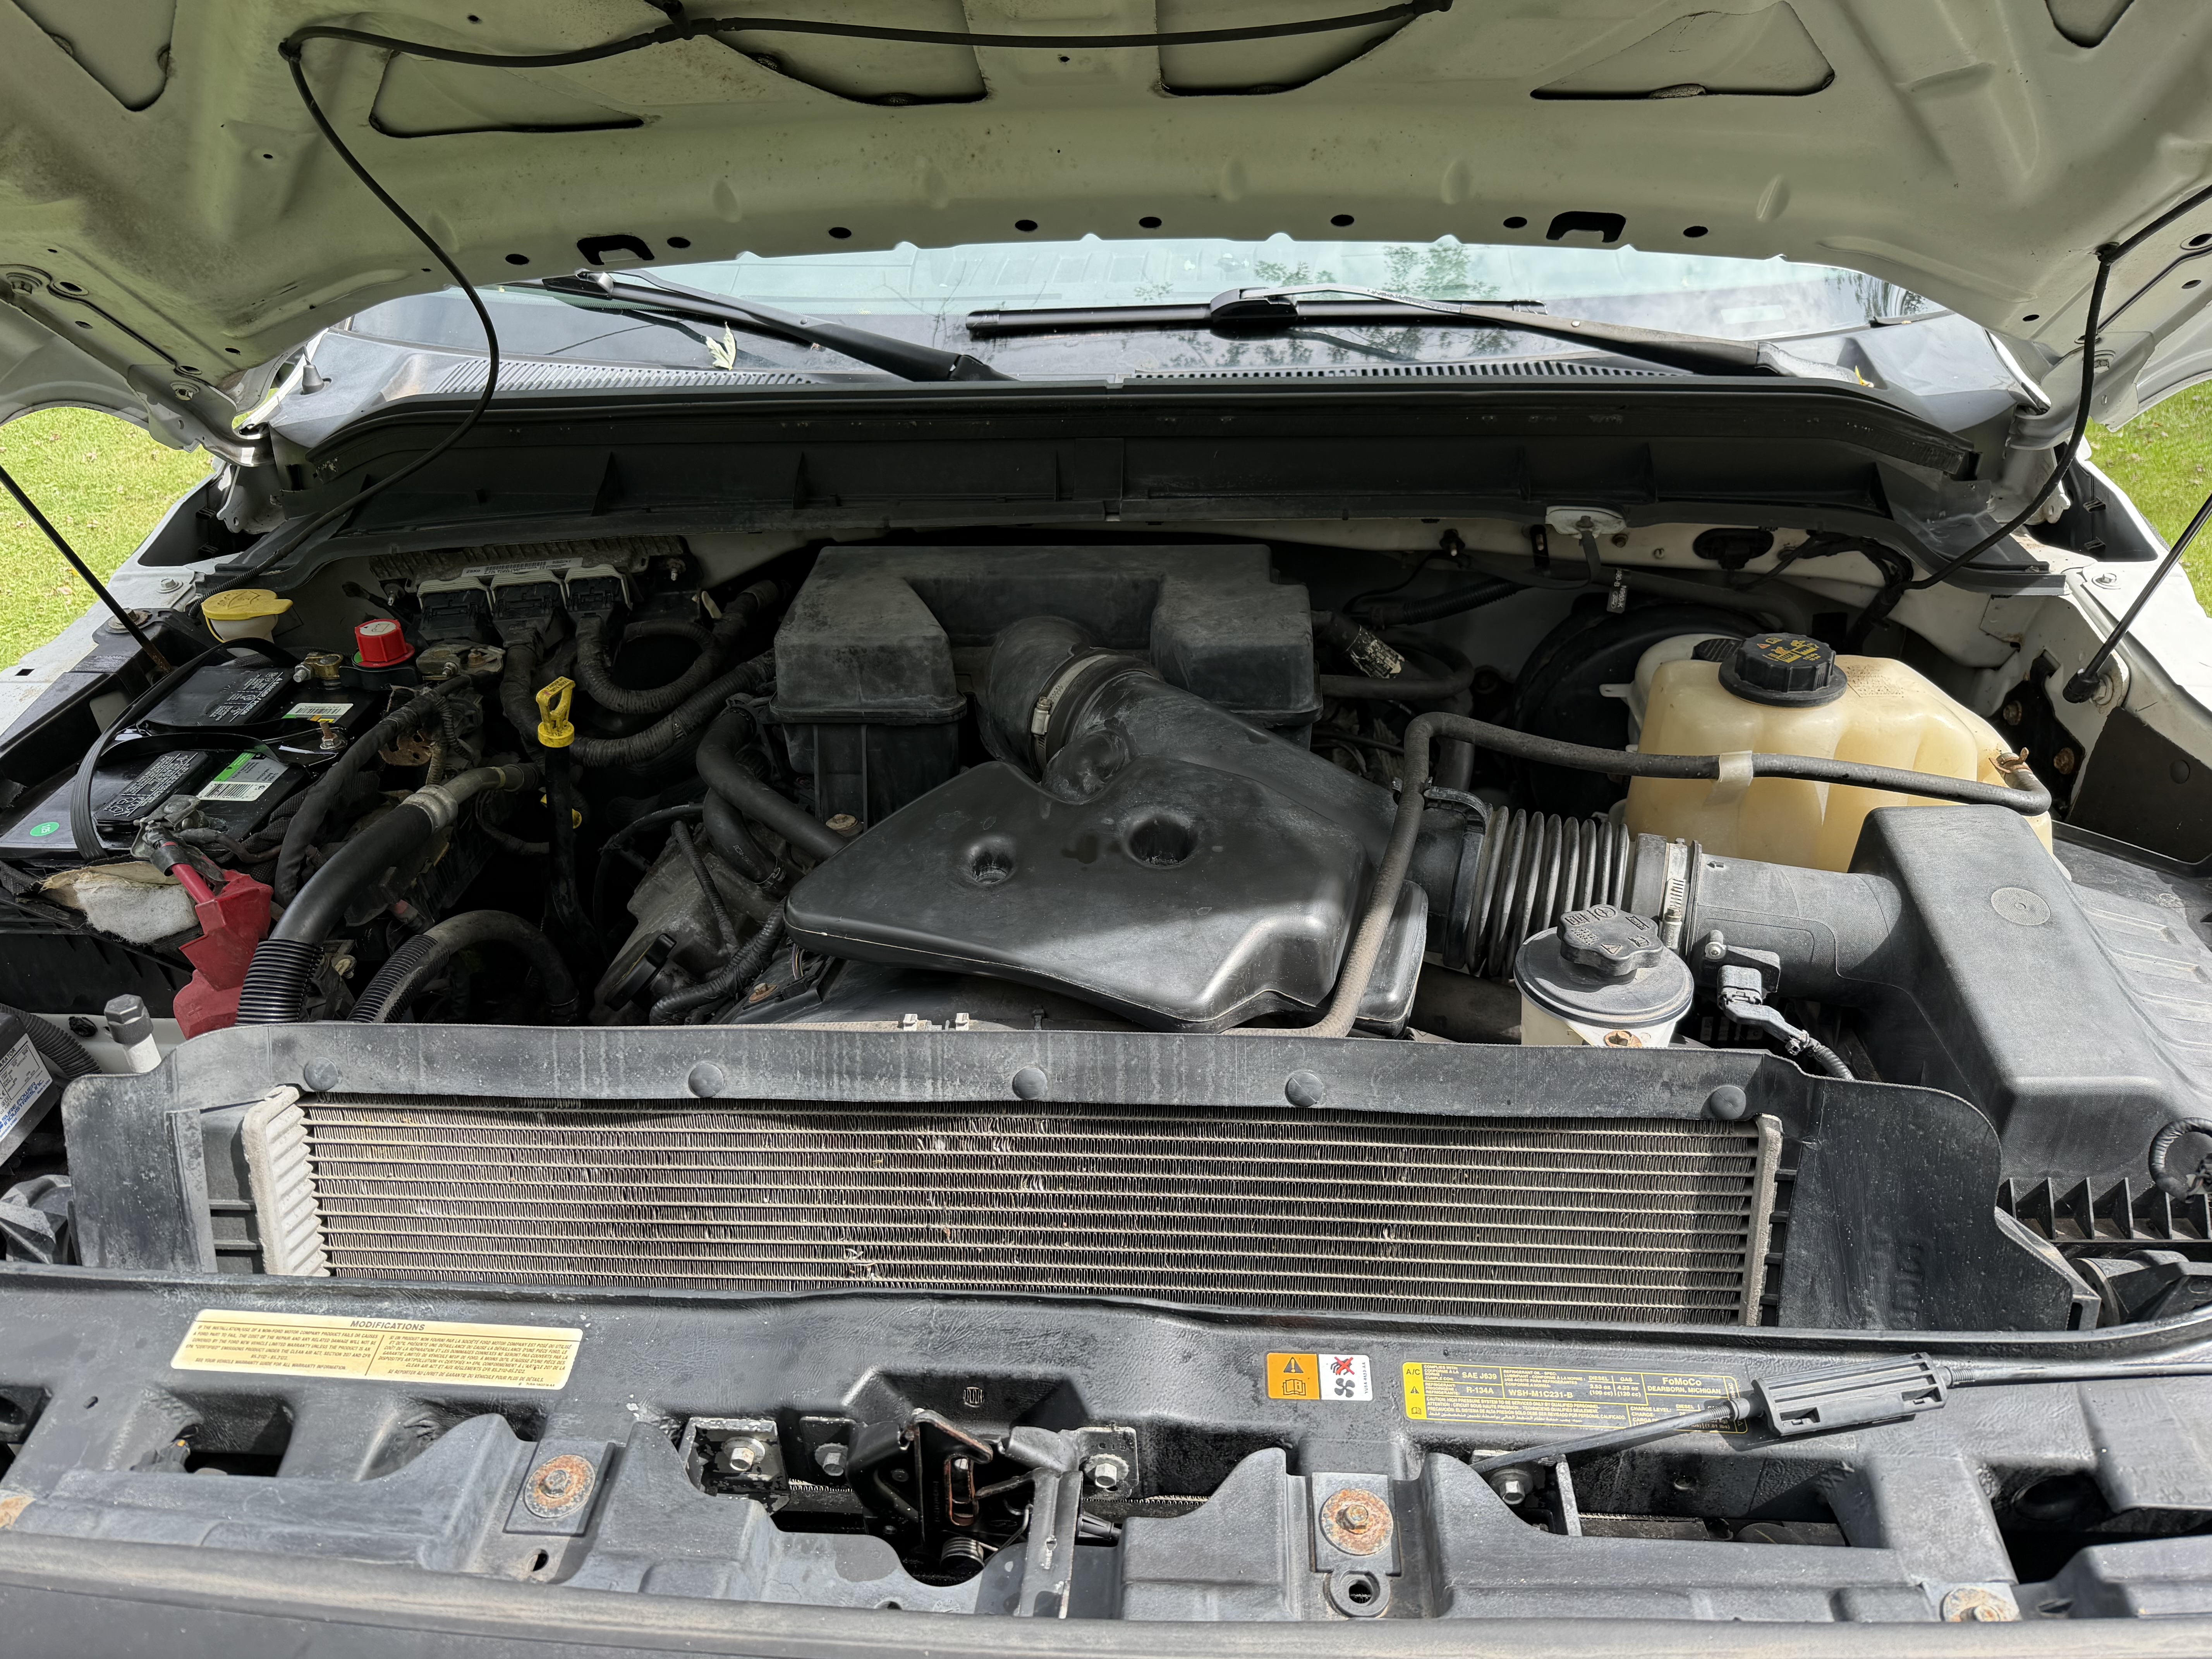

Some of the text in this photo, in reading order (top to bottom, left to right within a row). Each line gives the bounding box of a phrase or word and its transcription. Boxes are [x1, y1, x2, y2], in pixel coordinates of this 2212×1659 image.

[2, 1105, 17, 1122] SURE
[17, 1082, 37, 1104] POWER
[350, 1321, 425, 1331] MODIFICATIONS
[1662, 1377, 1702, 1386] FoMoCo
[1509, 1389, 1573, 1398] WSH-M1C231-B
[1688, 1387, 1722, 1395] MICHIGAN
